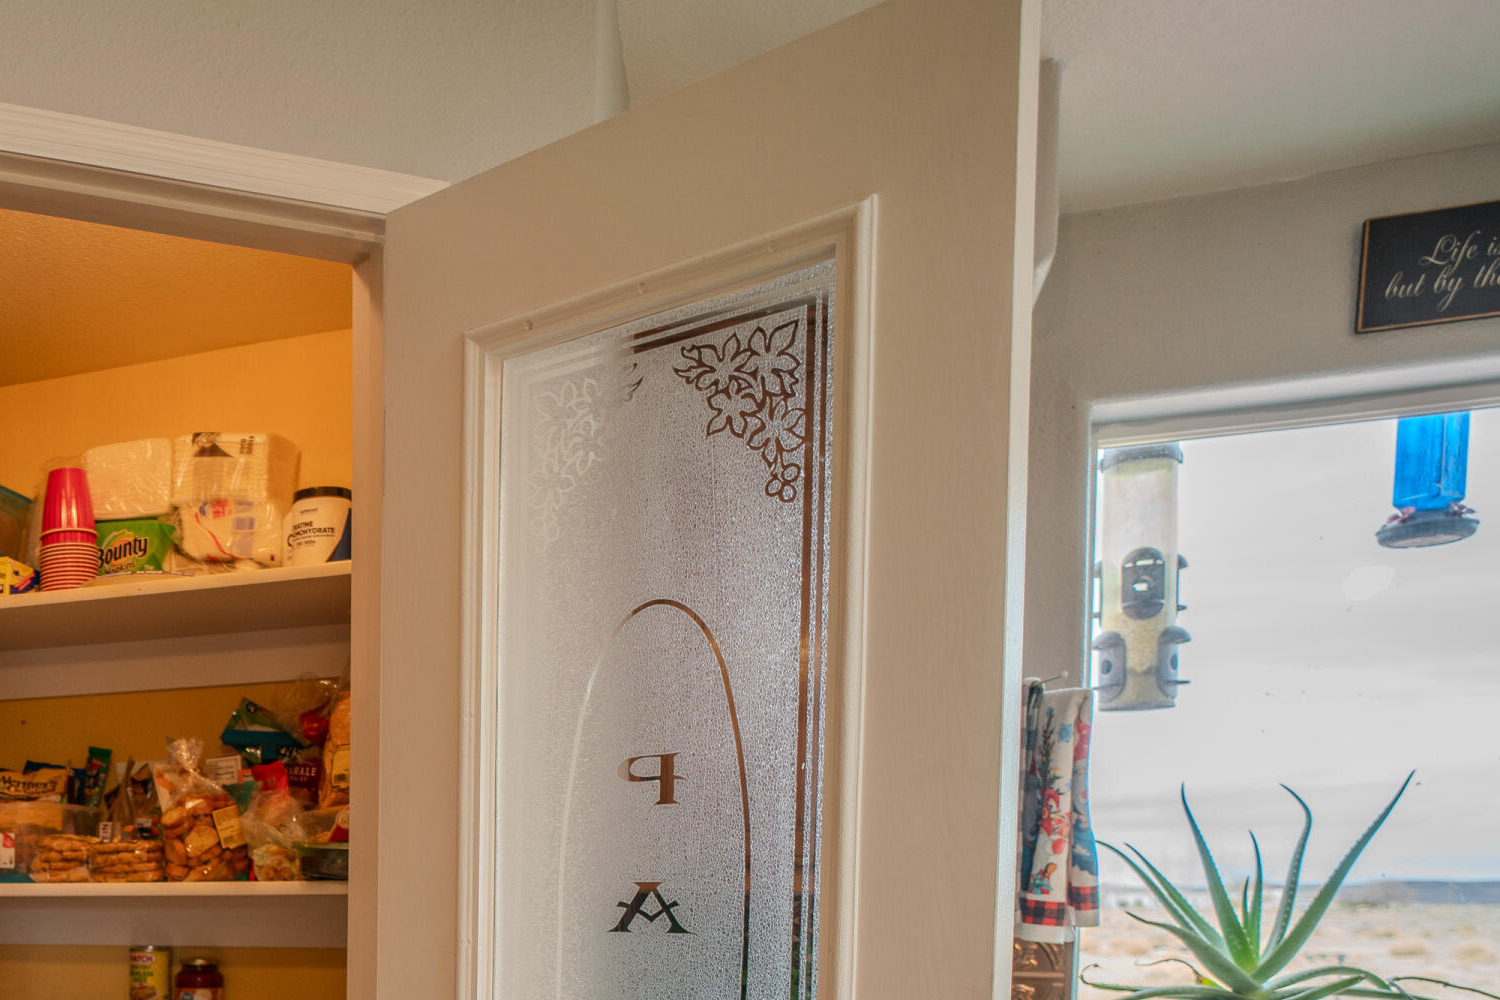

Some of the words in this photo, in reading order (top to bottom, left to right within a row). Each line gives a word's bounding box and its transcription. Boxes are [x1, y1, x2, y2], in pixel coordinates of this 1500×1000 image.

[1418, 230, 1482, 275] Life
[1385, 272, 1427, 300] but
[1434, 265, 1463, 312] by
[97, 536, 149, 569] Bounty
